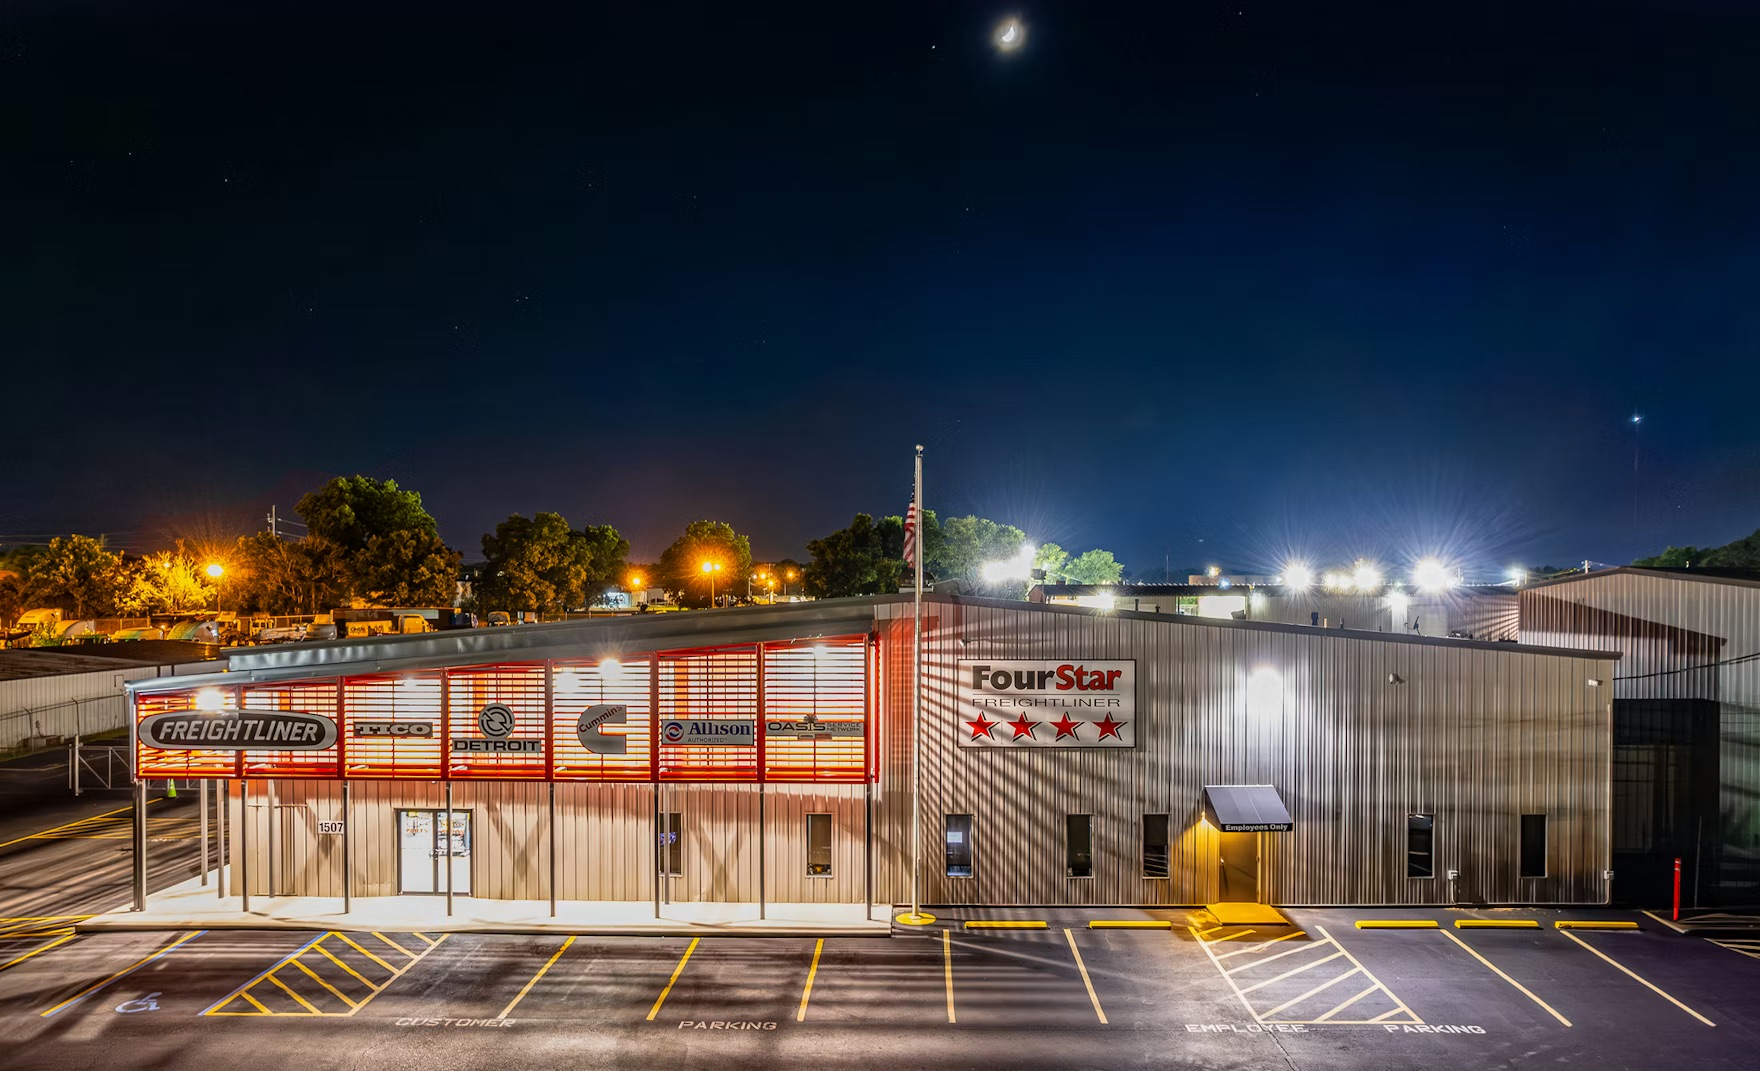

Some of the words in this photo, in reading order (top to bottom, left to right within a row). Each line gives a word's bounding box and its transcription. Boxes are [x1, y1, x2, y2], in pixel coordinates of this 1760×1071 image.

[972, 698, 1121, 708] FREIGHTLINER
[579, 704, 623, 733] Cummins
[158, 719, 318, 742] FREIGHTLINER
[355, 724, 431, 735] TICO
[688, 722, 751, 735] Allison
[454, 740, 540, 752] DETROIT
[319, 822, 343, 832] 1507
[396, 1018, 516, 1028] CUSTOMER
[678, 1020, 777, 1030] PARKING
[1185, 1024, 1308, 1033] EMPLOYEE
[1384, 1024, 1486, 1034] PARKING
